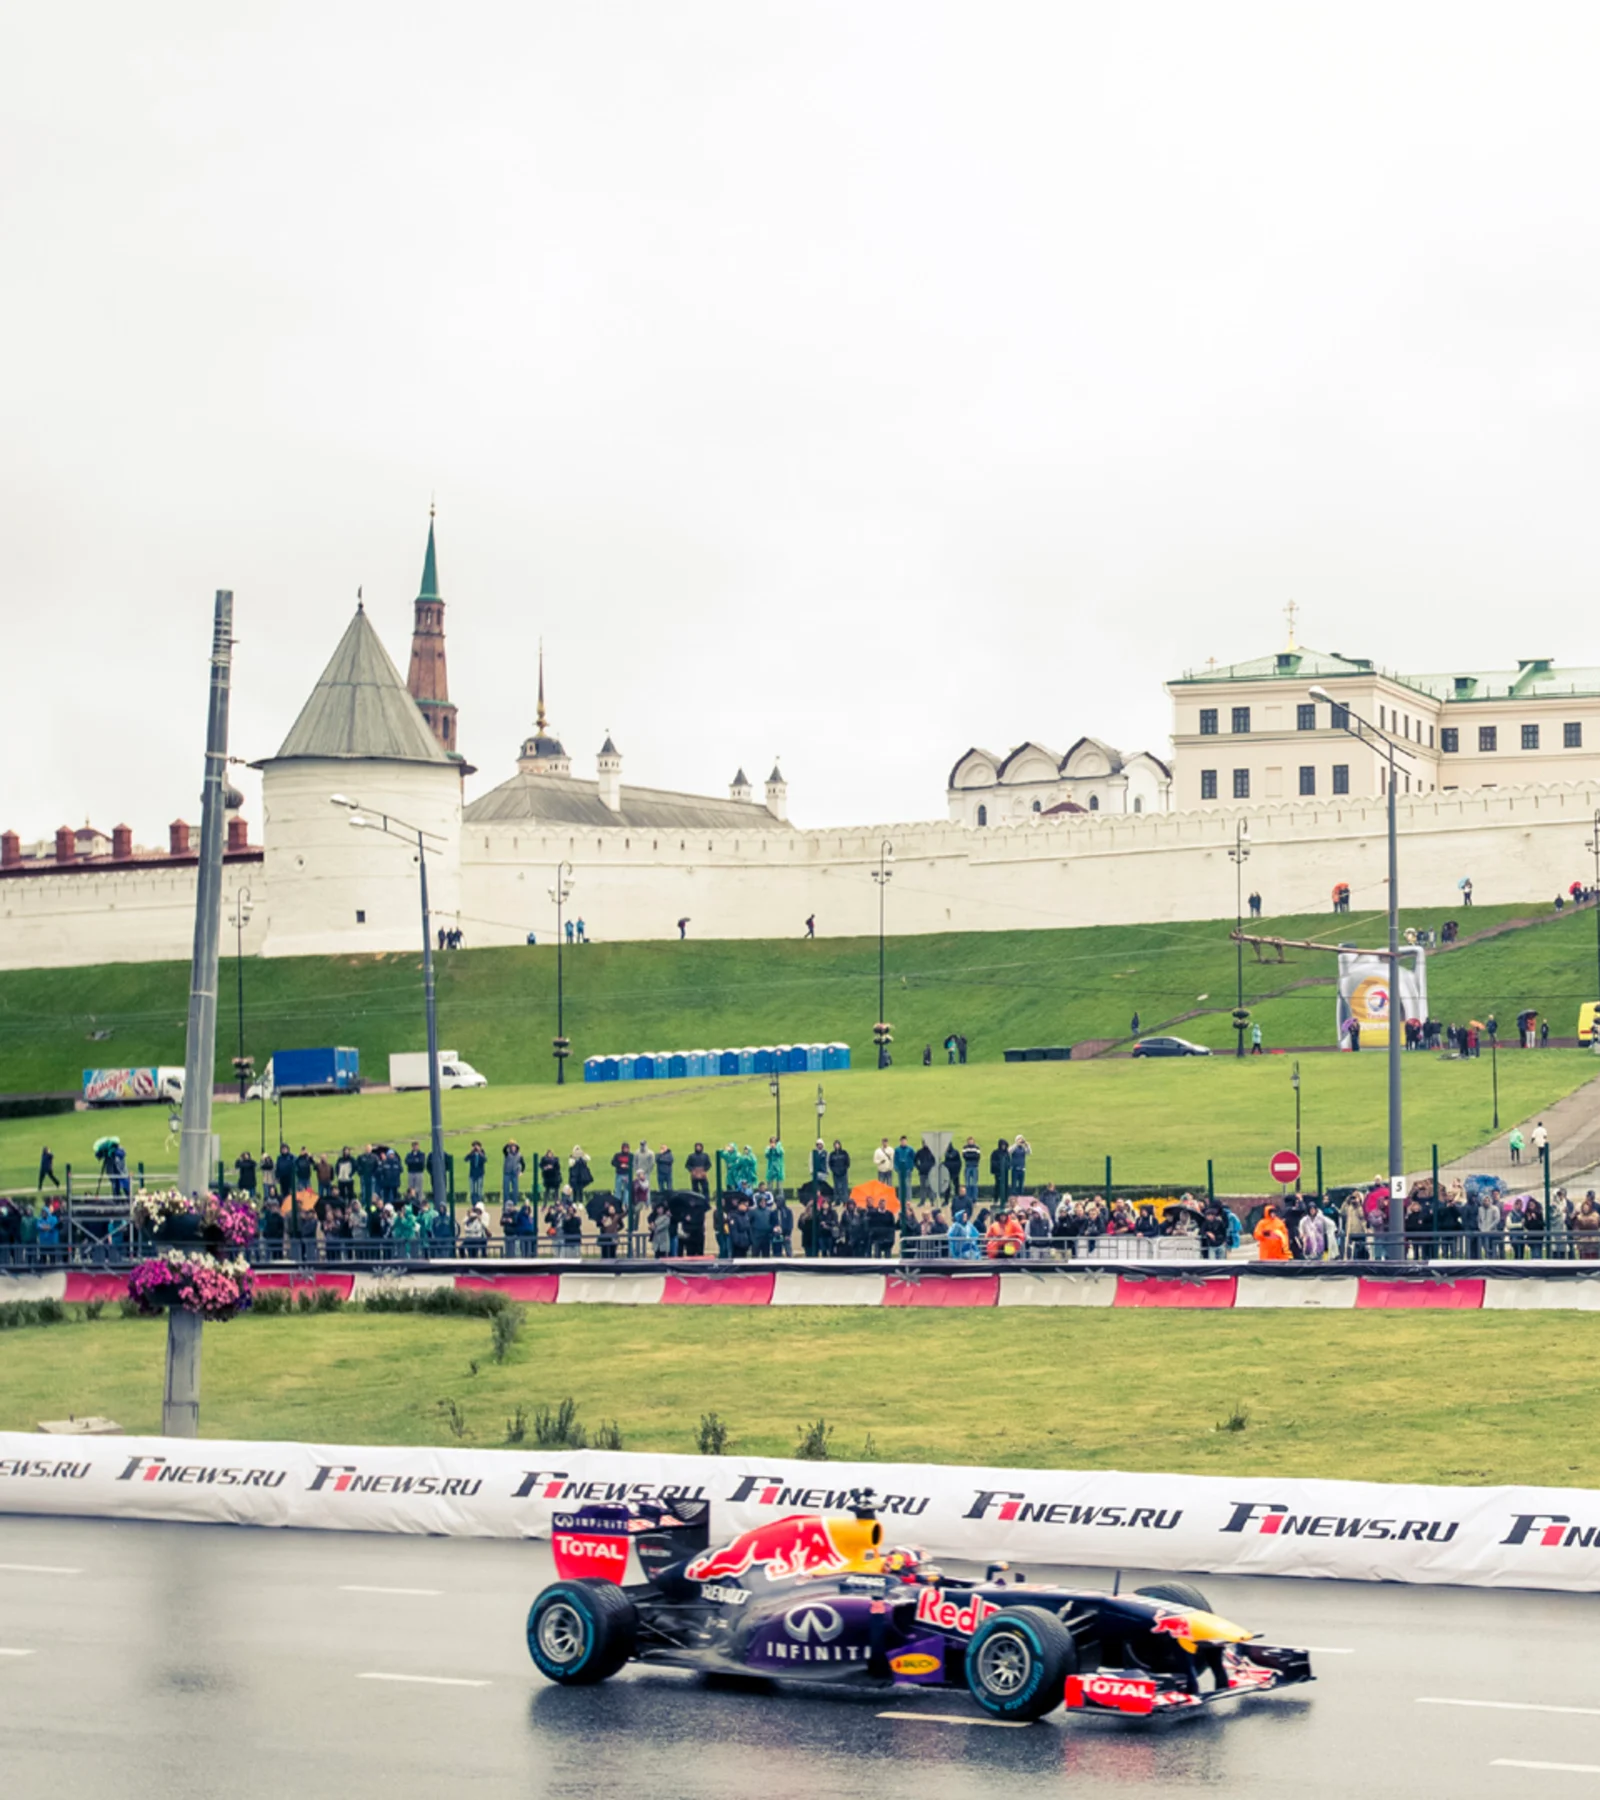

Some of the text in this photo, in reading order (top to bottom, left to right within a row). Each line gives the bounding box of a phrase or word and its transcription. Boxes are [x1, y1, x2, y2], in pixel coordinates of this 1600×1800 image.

[1395, 1181, 1403, 1192] 5
[766, 1641, 873, 1661] INFINITI
[1077, 1675, 1153, 1699] TOTAL
